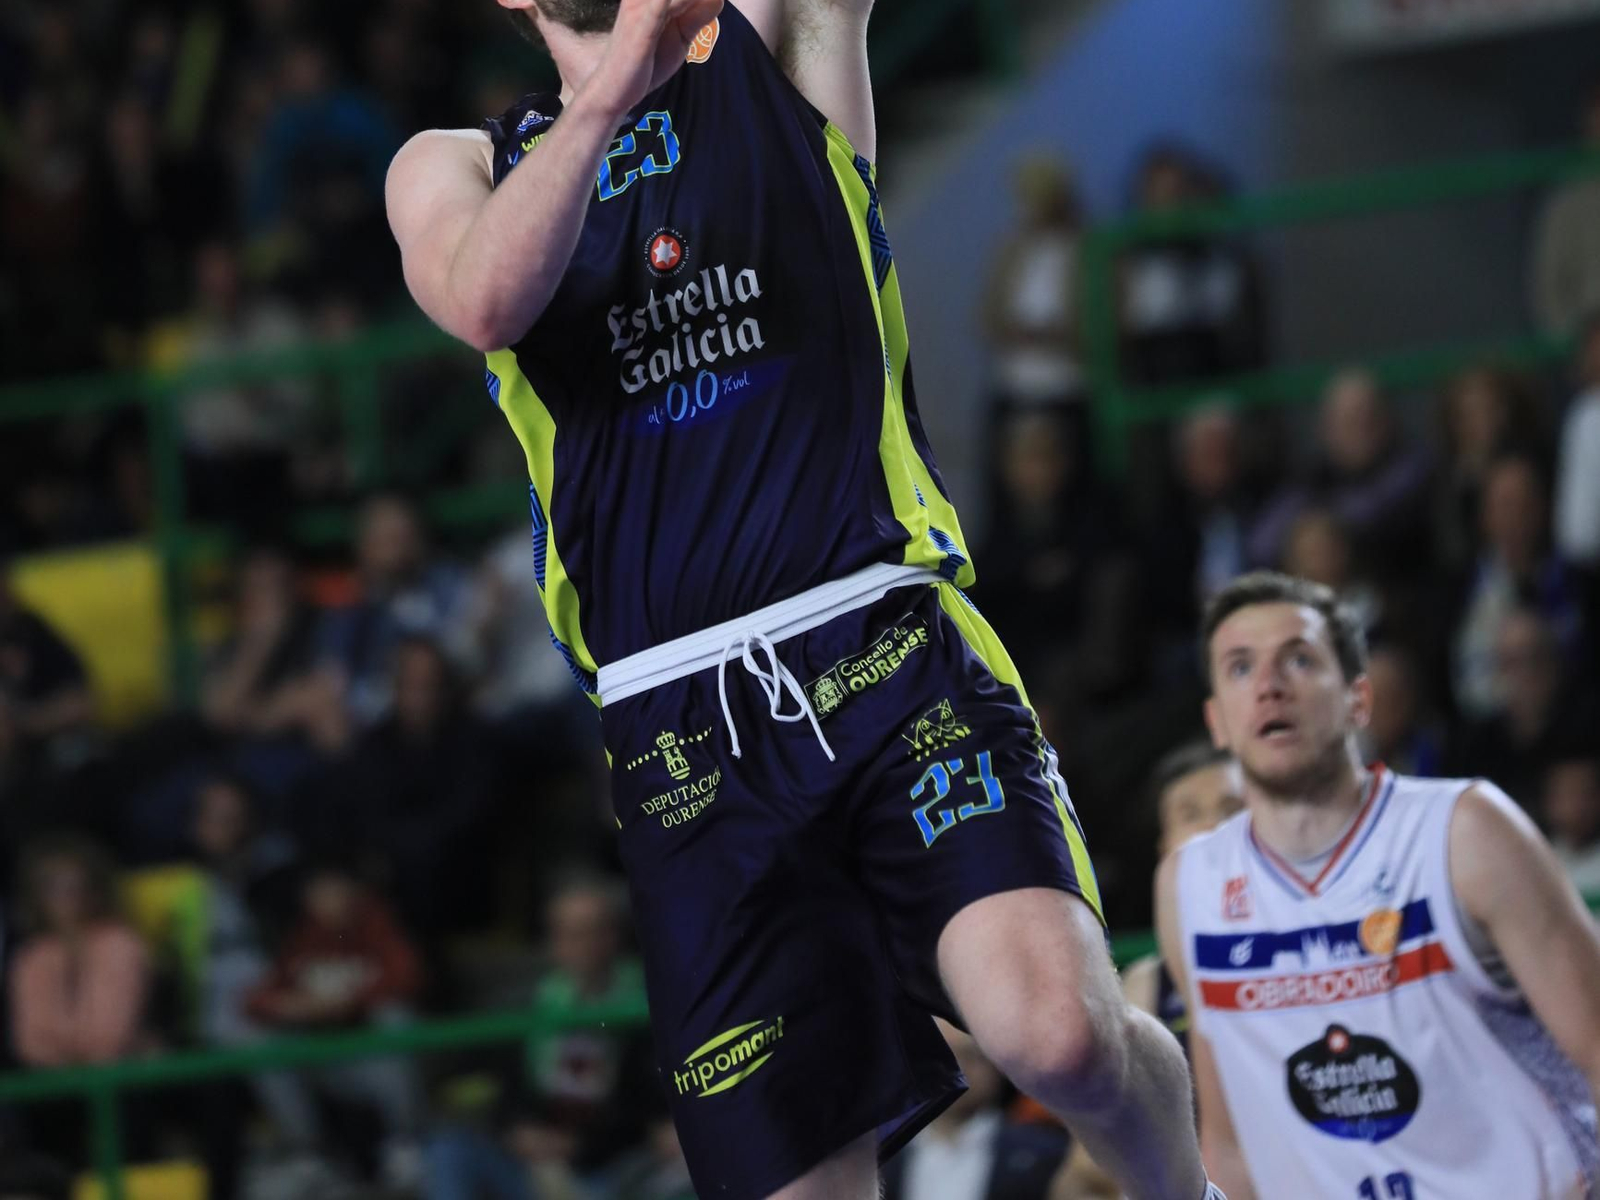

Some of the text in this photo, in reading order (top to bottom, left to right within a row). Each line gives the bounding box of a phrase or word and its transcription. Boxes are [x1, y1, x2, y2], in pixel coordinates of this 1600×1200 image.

[597, 110, 681, 202] 23
[607, 264, 763, 354] Estrella
[619, 313, 767, 394] Galicia
[666, 369, 718, 422] 0,0
[841, 626, 908, 677] Concello de
[849, 627, 928, 692] OURENSE
[662, 788, 717, 829] OURENSE
[910, 750, 1005, 849] 23
